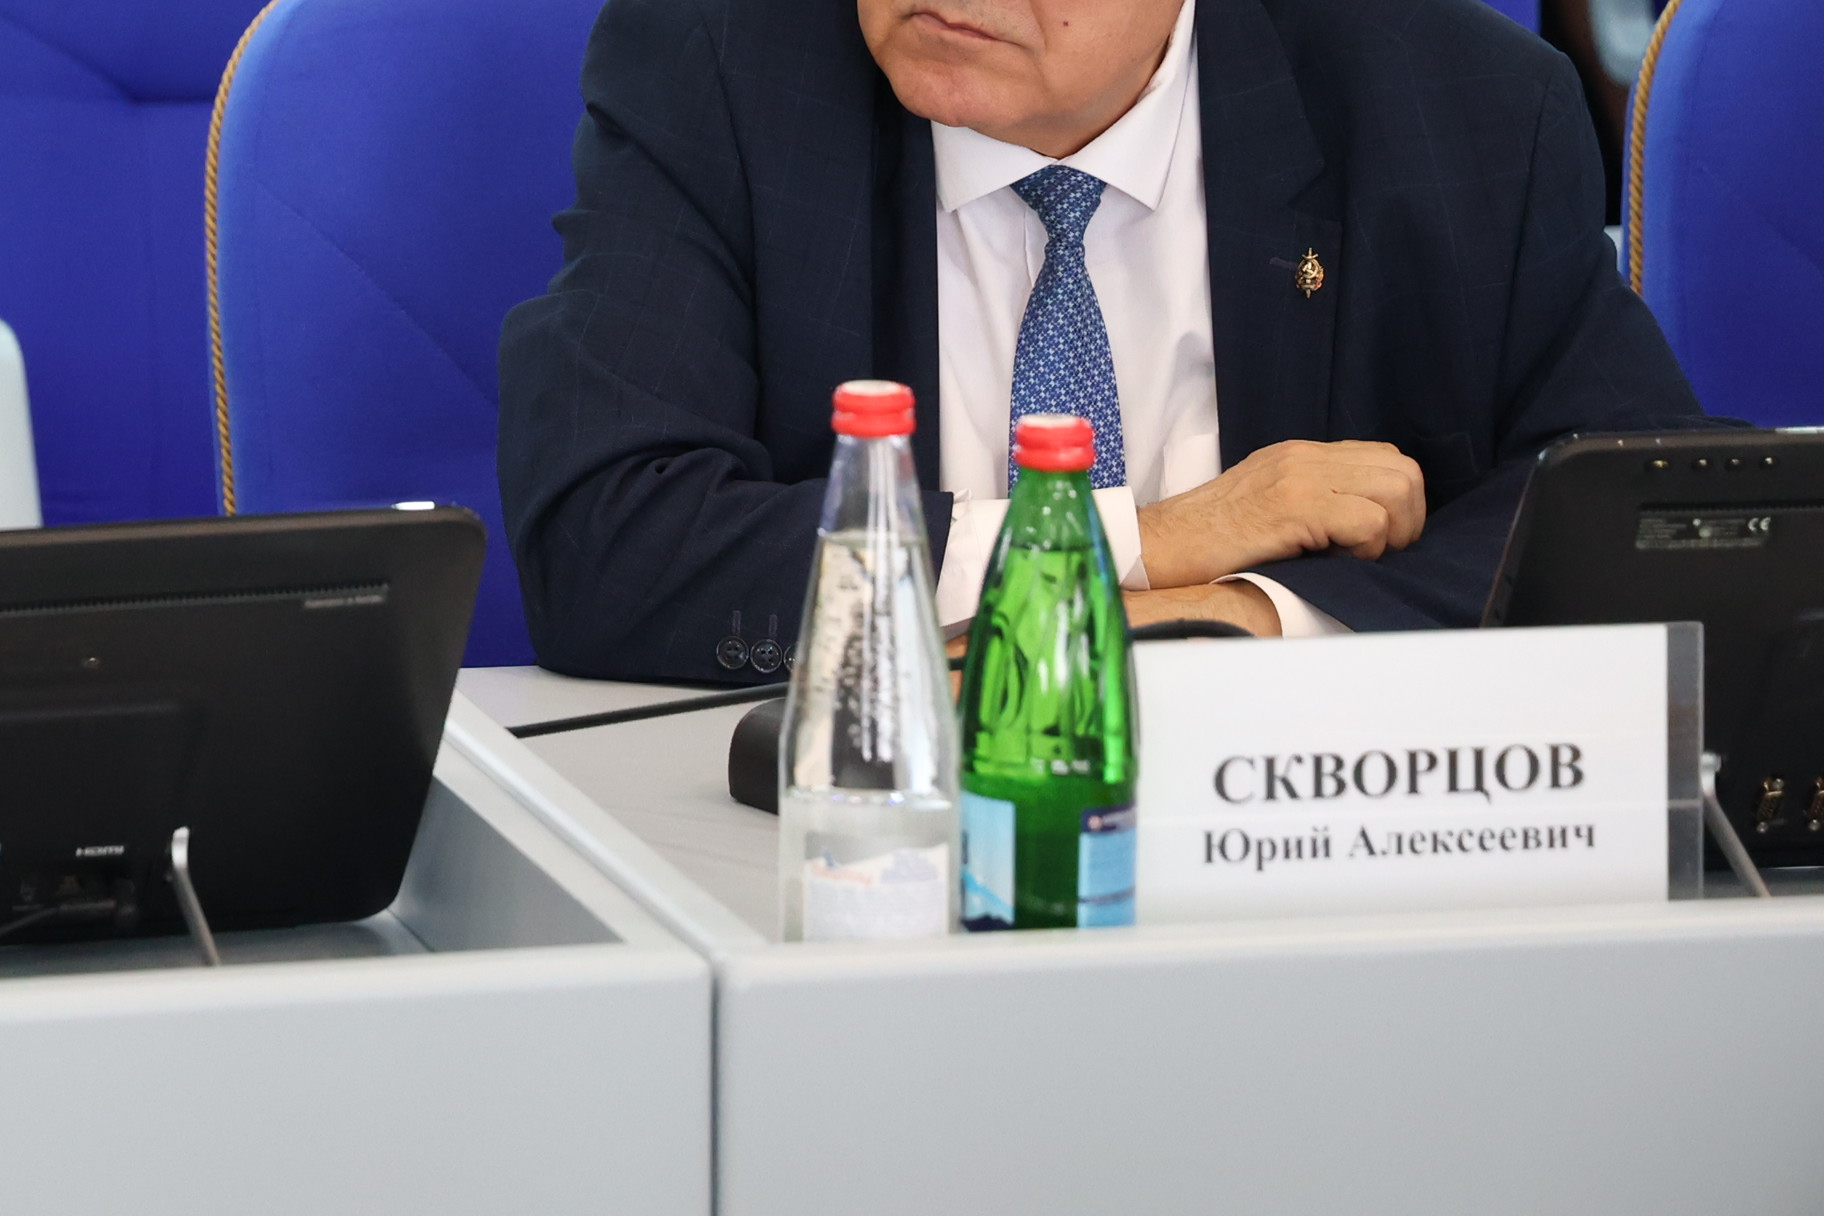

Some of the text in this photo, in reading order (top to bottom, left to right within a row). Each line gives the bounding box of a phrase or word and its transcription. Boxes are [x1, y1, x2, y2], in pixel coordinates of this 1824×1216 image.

[1212, 742, 1586, 805] СКВОРЦОВ
[1202, 822, 1596, 872] Юрий Алексеевич
